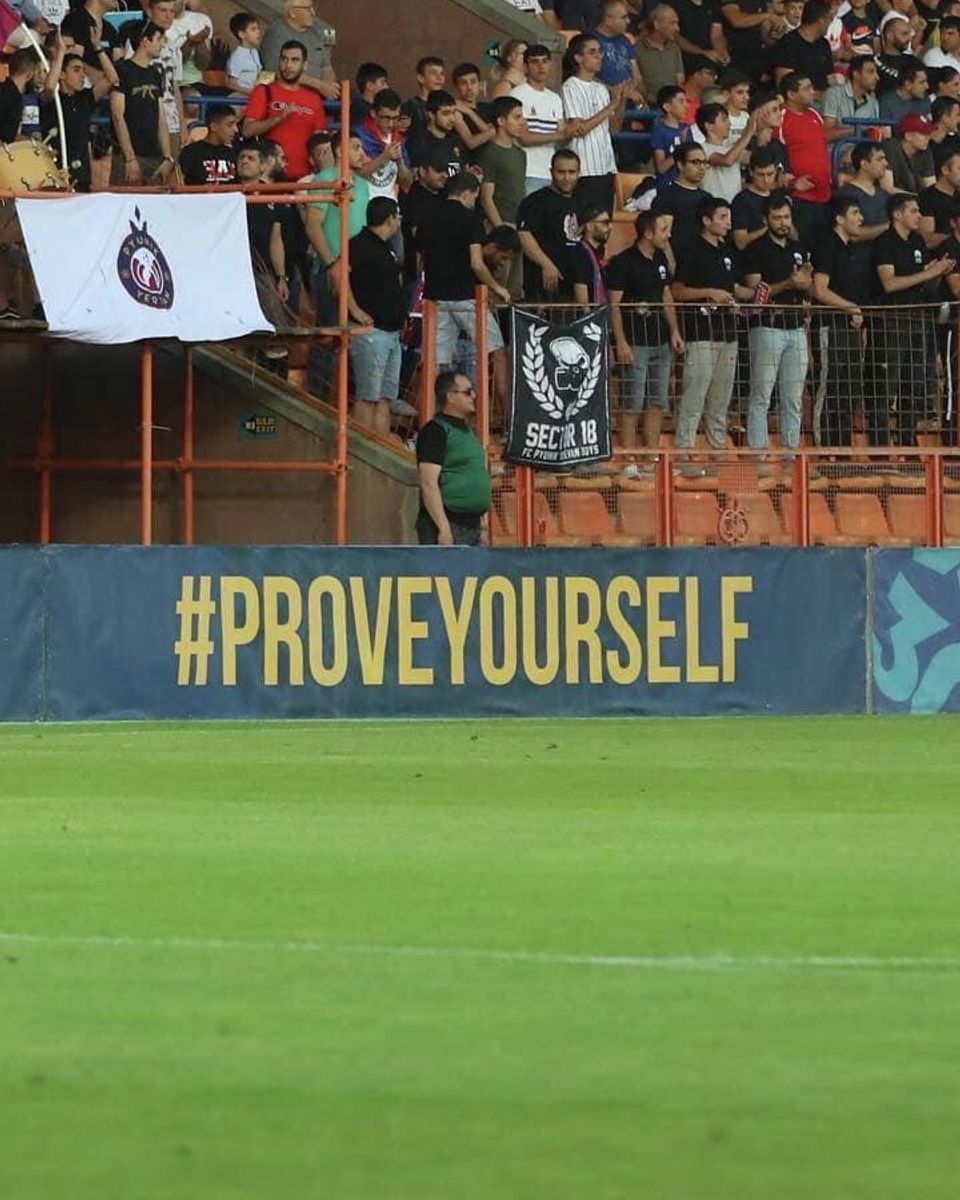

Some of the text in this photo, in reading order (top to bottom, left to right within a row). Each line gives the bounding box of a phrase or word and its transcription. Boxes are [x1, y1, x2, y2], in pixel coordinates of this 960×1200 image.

[525, 419, 597, 450] SECTR 18
[174, 575, 753, 687] #PROVEYOURSELF
